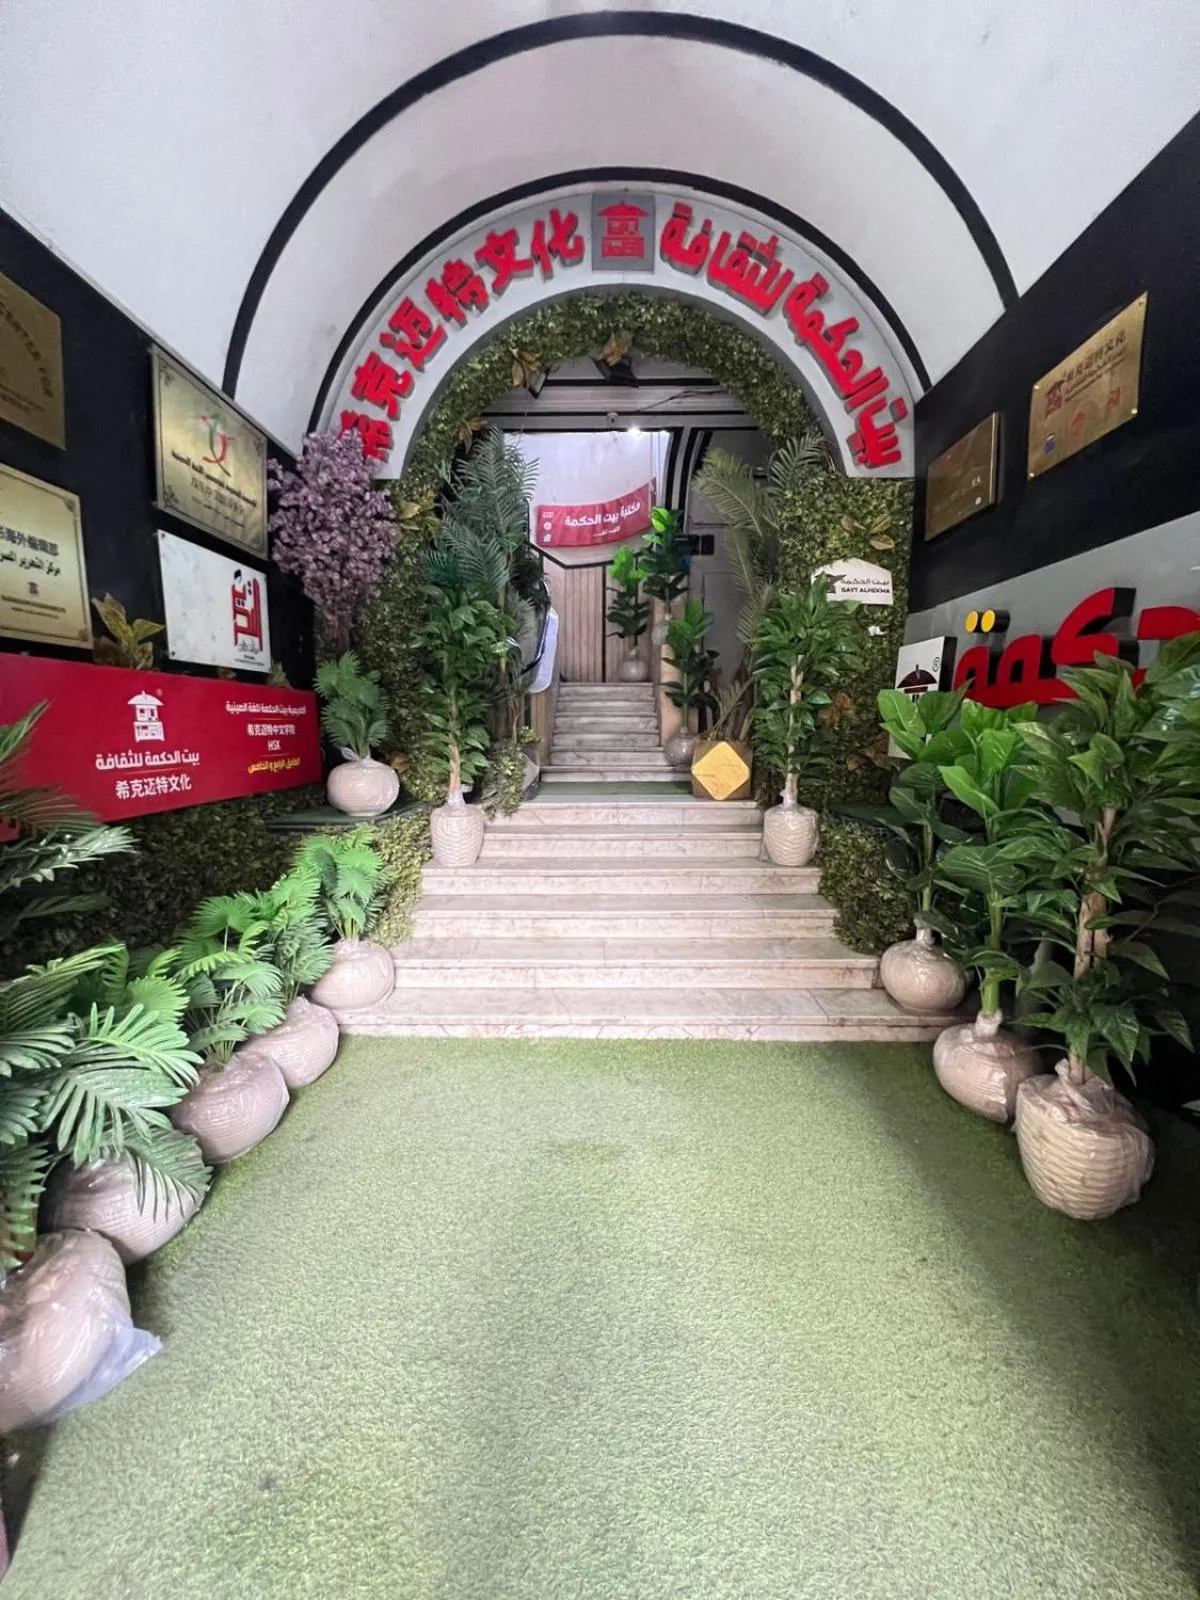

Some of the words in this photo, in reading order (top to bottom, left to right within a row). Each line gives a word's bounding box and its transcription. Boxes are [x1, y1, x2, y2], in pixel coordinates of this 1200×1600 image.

[660, 202, 795, 316] للثقافة
[783, 272, 891, 410] الحكمة
[847, 397, 909, 469] بيت
[564, 514, 602, 527] الحكمة
[603, 512, 619, 523] بيت
[267, 740, 281, 751] HSK
[95, 749, 143, 770] للثقافة
[144, 750, 181, 766] الحكمة
[180, 749, 200, 766] بيت
[115, 773, 192, 800] 希克迈特文化
